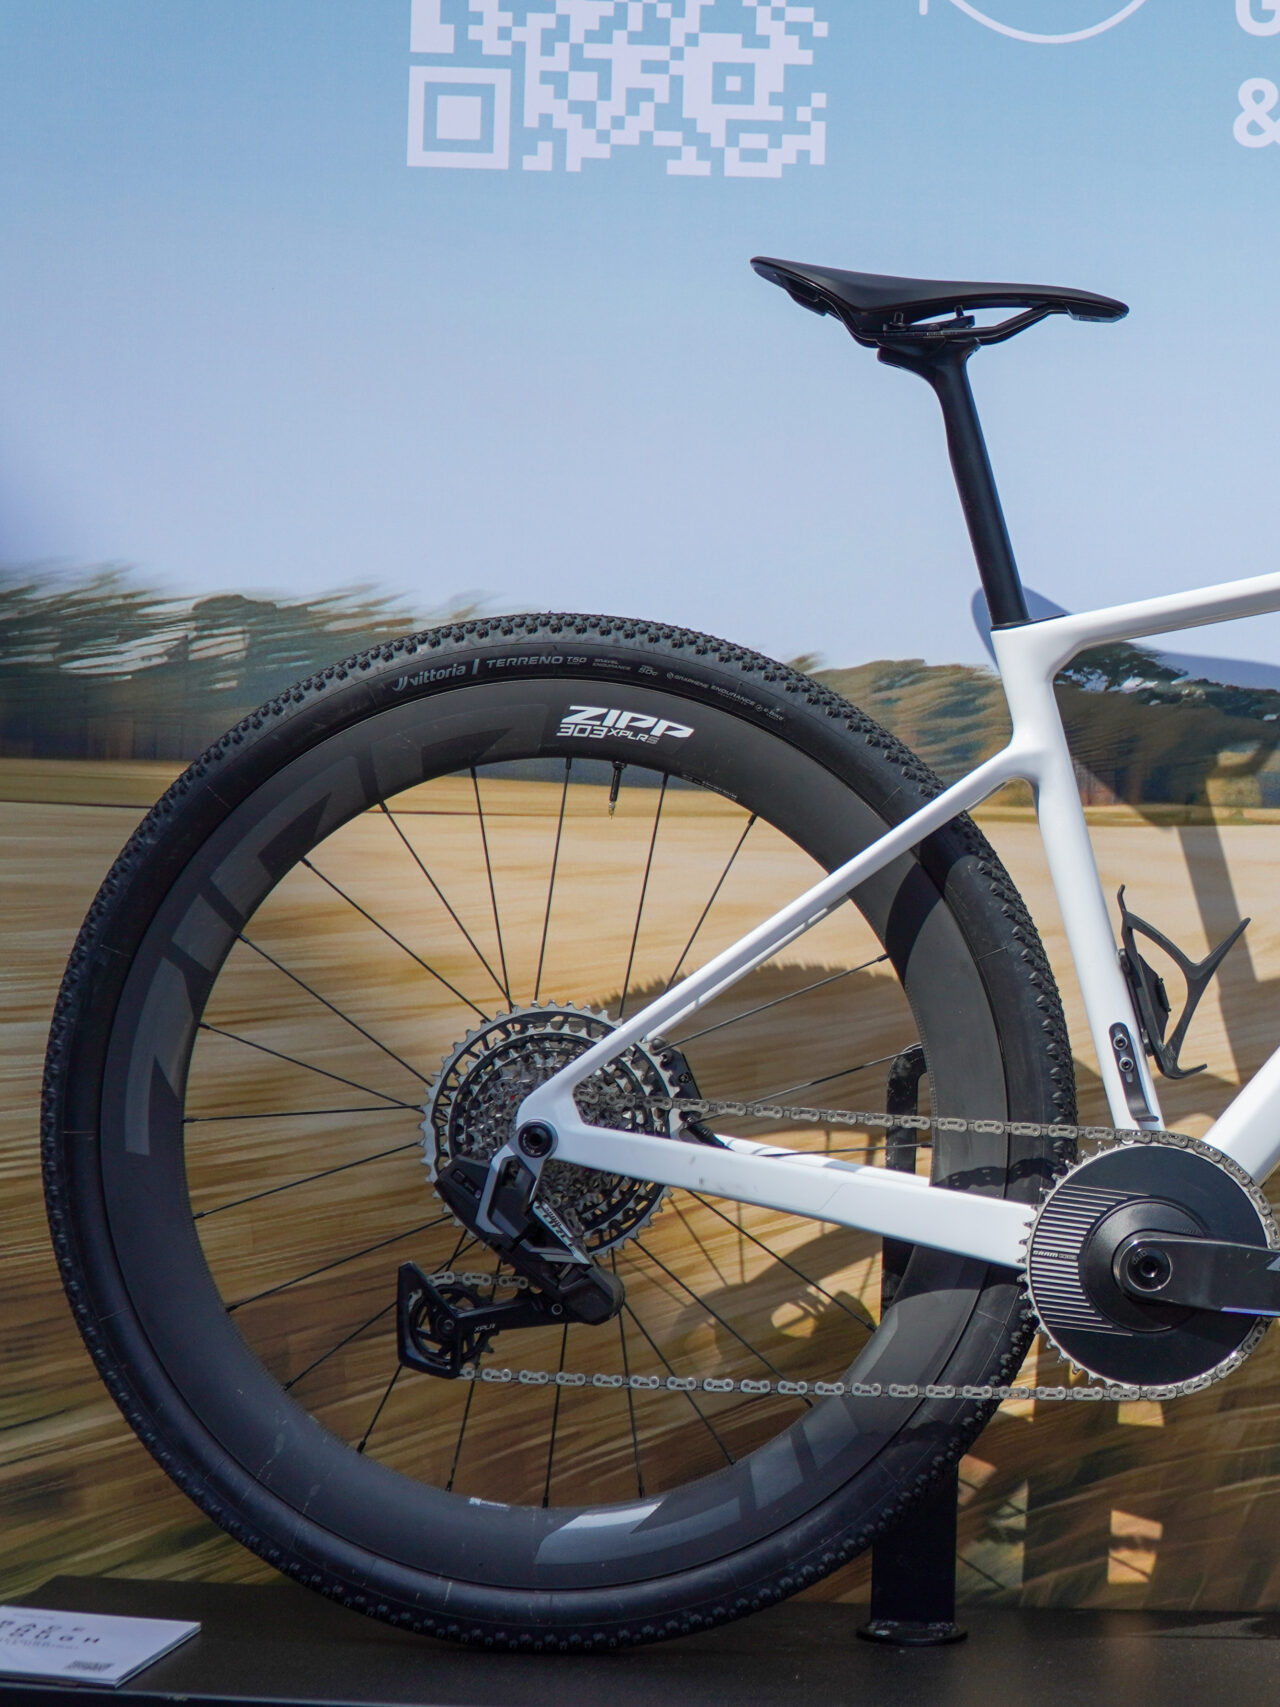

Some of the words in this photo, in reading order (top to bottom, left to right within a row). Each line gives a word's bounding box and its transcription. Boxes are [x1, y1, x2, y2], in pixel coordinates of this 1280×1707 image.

[409, 663, 466, 687] vittoria
[486, 655, 563, 668] TERRENO
[711, 685, 756, 707] ENDURANCE
[556, 724, 608, 739] 303
[561, 705, 695, 738] ZIPP
